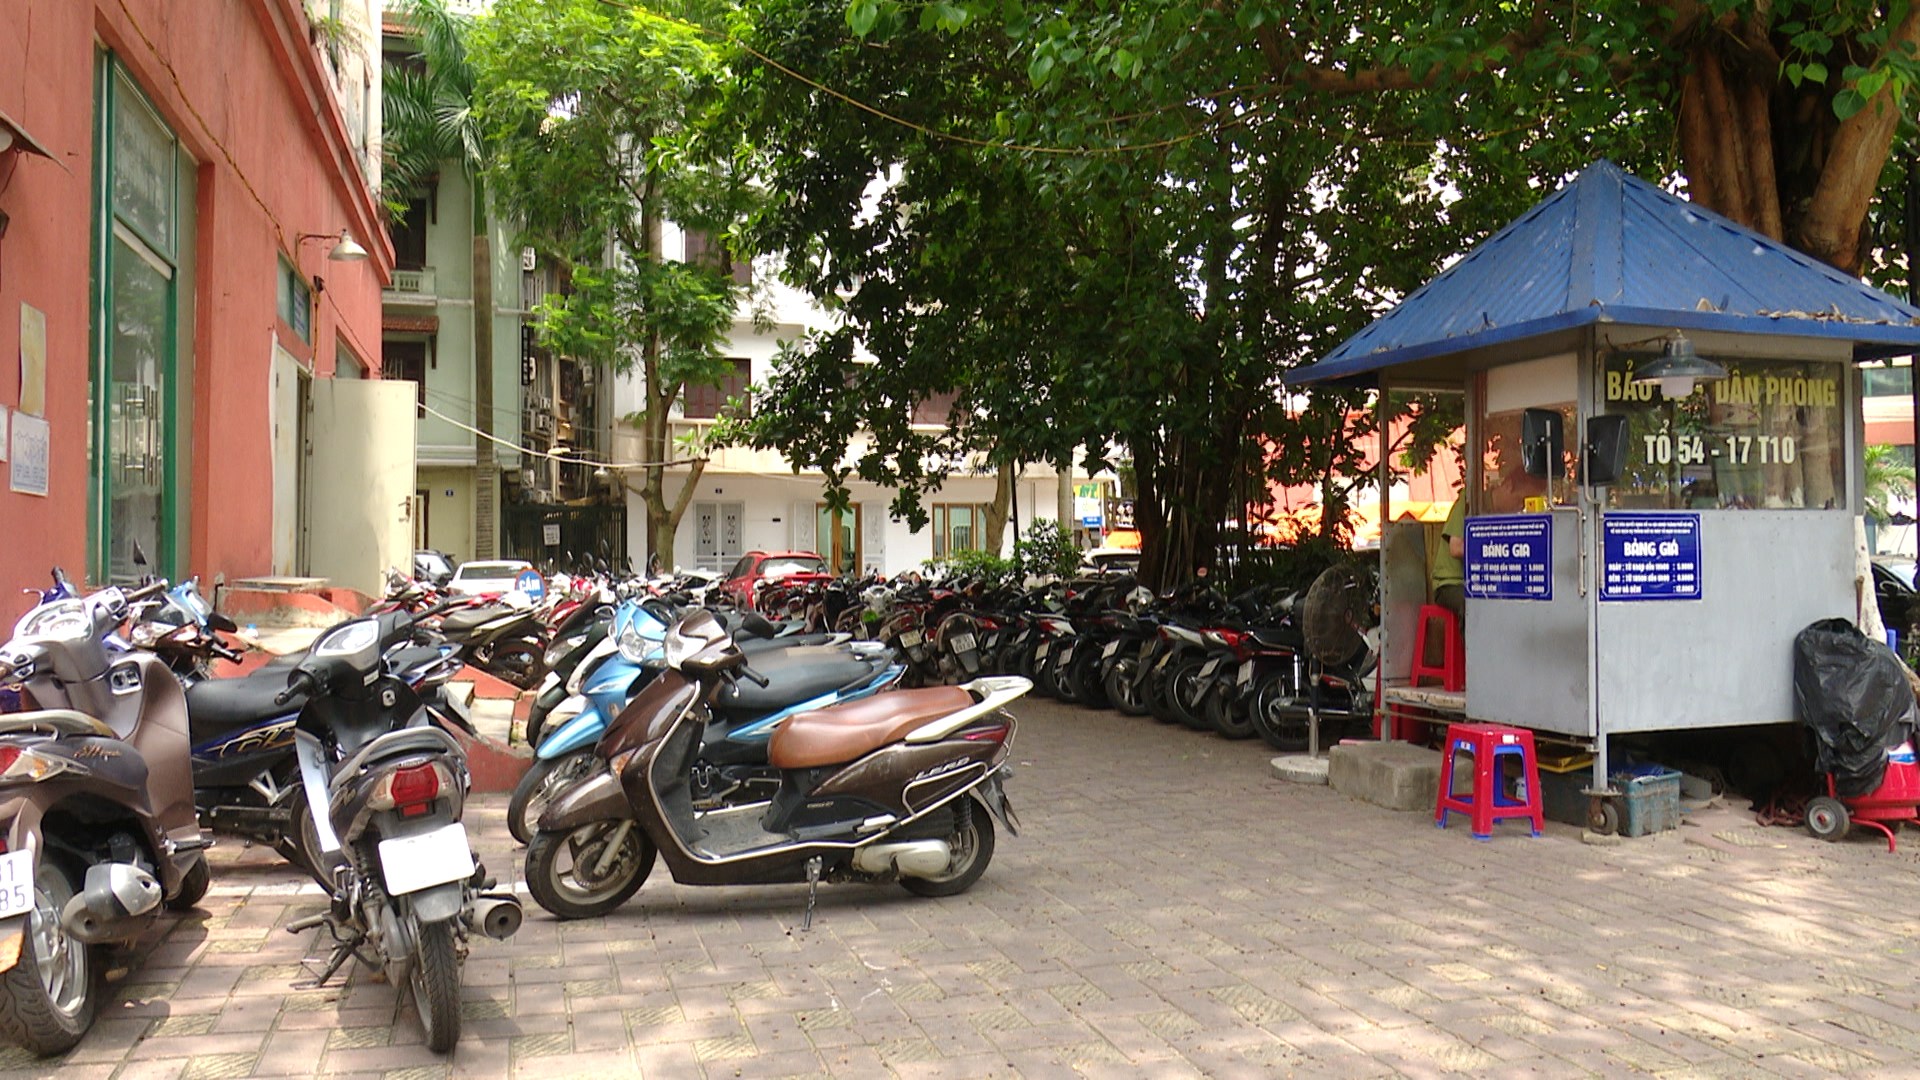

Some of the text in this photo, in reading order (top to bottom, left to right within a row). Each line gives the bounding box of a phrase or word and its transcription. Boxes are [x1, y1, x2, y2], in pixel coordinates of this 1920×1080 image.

[1643, 419, 1672, 464] TỔ
[1678, 435, 1705, 464] 54
[1726, 436, 1752, 464] 17
[1757, 436, 1795, 464] T10
[0, 859, 14, 882] 1
